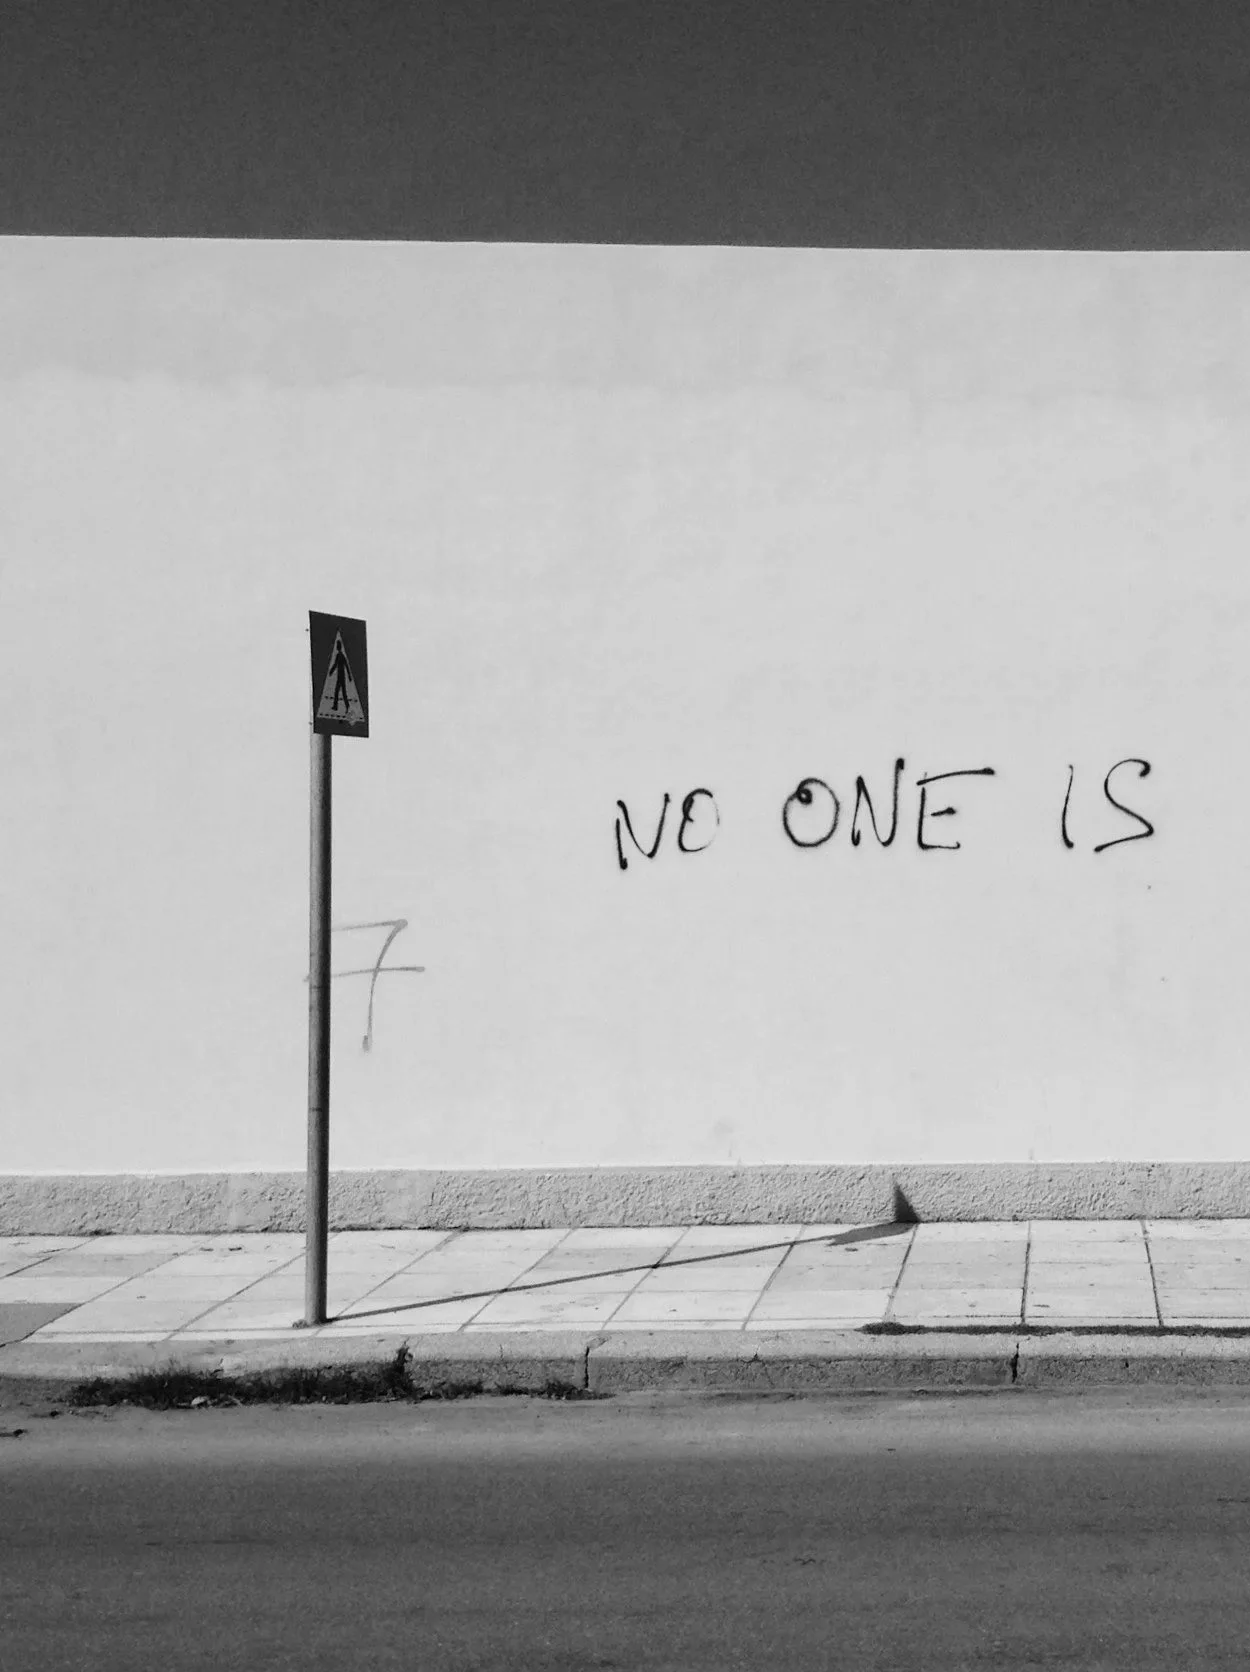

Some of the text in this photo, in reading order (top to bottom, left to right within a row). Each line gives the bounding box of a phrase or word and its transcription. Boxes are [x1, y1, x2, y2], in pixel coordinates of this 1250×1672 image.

[614, 787, 721, 871] NO
[780, 757, 996, 850] ONE
[1060, 758, 1156, 853] IS
